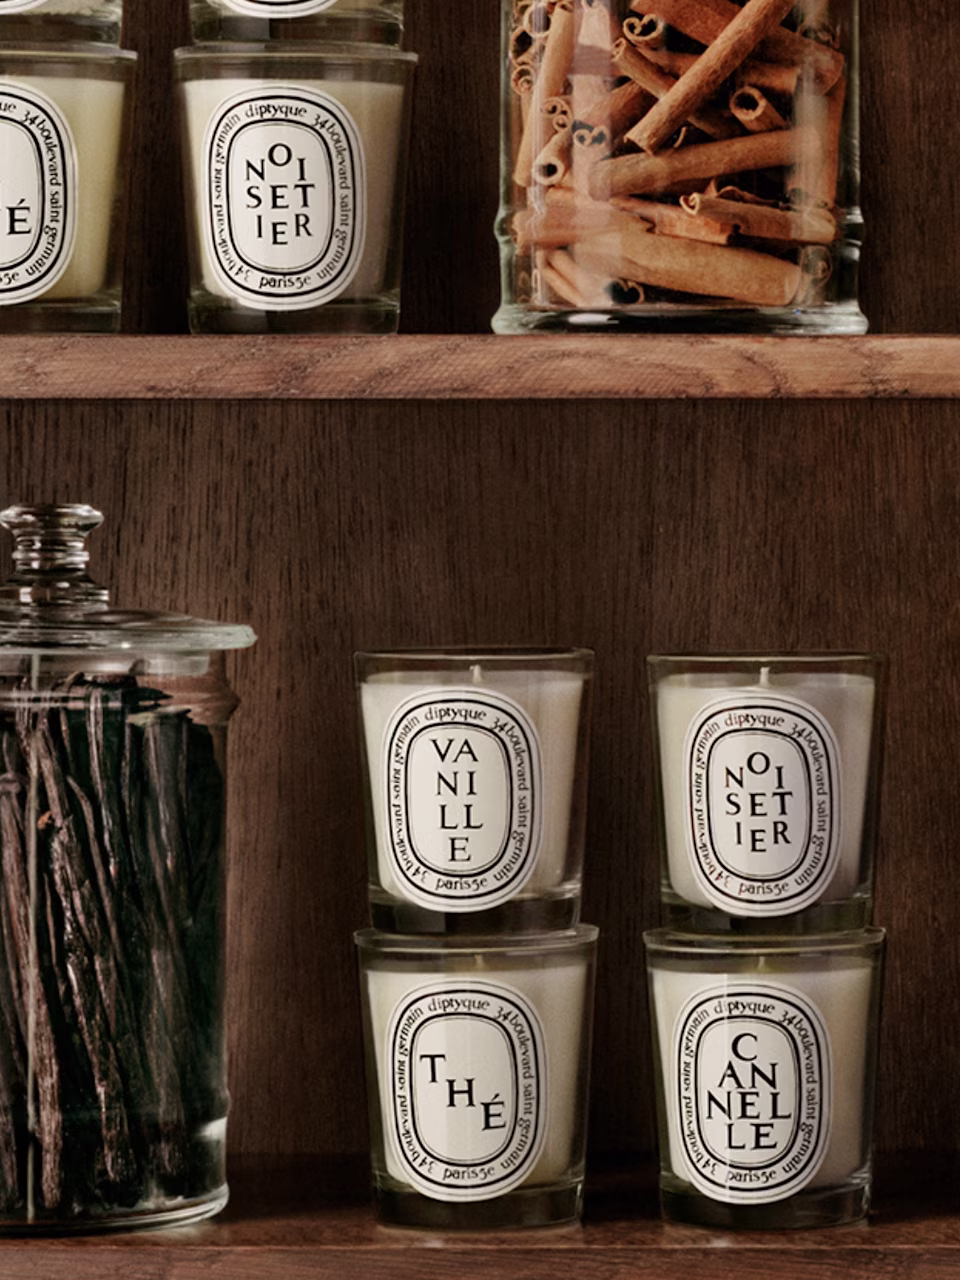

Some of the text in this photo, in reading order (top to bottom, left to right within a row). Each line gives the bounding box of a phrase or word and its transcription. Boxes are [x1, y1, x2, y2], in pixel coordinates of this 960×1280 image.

[245, 102, 307, 120] diptyque
[423, 706, 487, 724] diptyque
[723, 712, 786, 731] diptyque
[427, 996, 491, 1014] diptyque
[713, 999, 776, 1018] diptyque
